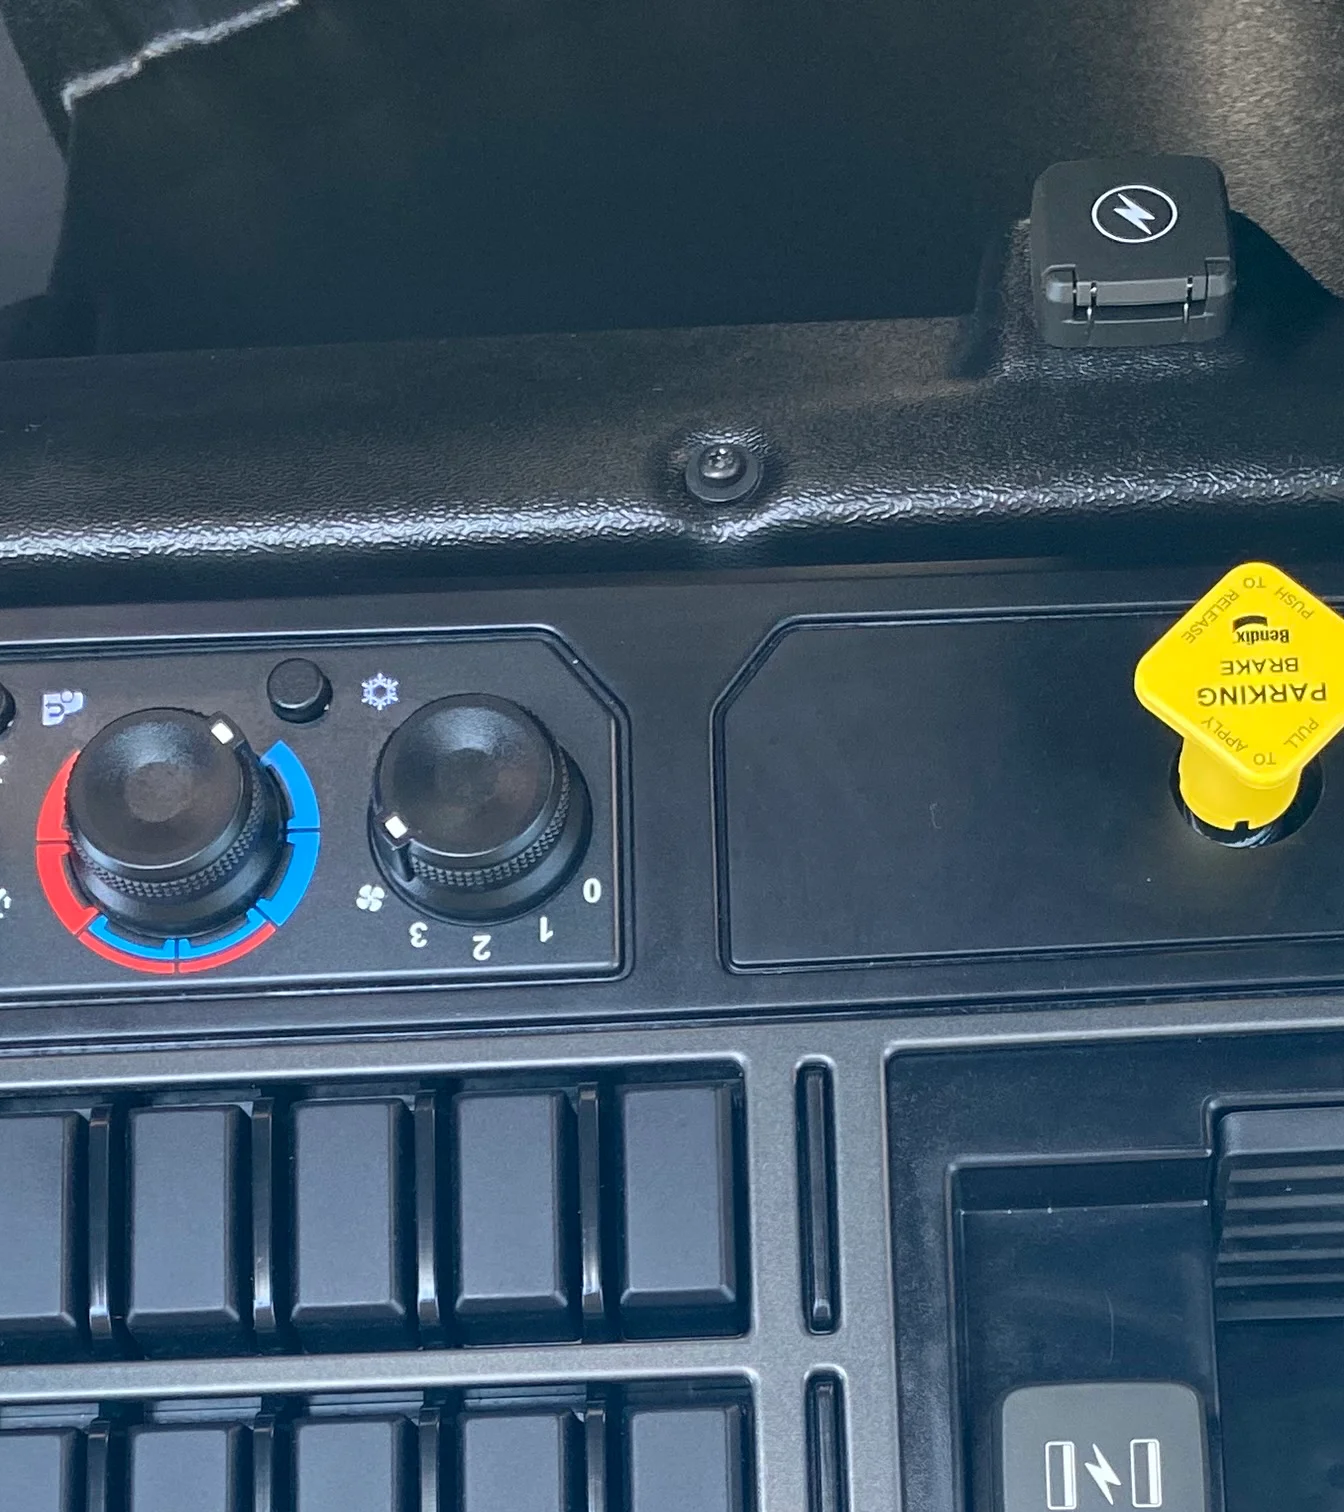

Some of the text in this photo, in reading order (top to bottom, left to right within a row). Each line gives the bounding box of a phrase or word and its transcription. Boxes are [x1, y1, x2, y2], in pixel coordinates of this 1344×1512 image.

[1181, 577, 1315, 644] PUSH TO RELEASE
[1236, 629, 1289, 645] Bendix
[1220, 657, 1298, 676] BRAKE
[1197, 682, 1326, 707] PARKING
[1201, 716, 1319, 765] PULL TO APPLY
[409, 922, 428, 948] 3
[539, 916, 554, 943] 1
[472, 934, 492, 961] 2
